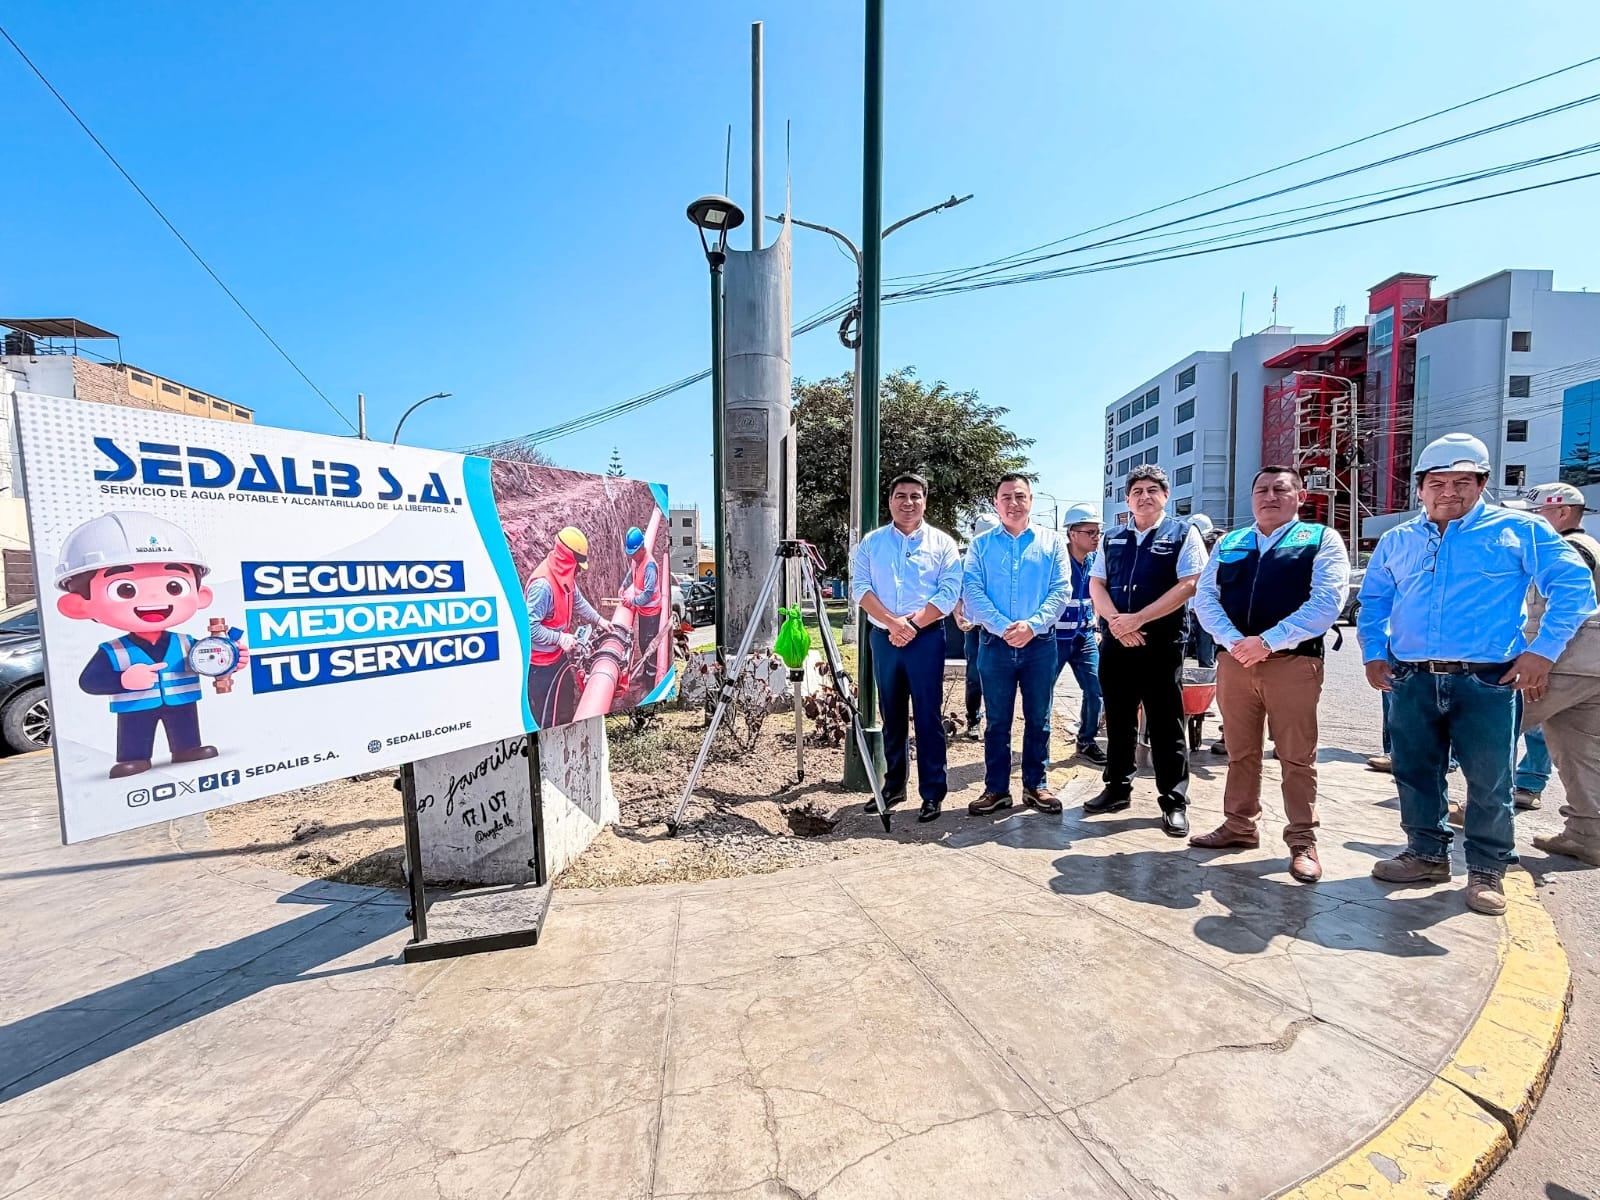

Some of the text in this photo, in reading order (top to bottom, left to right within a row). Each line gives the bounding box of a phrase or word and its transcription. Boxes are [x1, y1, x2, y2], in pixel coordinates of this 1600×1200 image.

[100, 484, 458, 514] SERVICIO DE AGUA POTABLE Y ALCANTARILLADO DE LA LIBERTAD S.A.
[378, 467, 462, 505] S.A.
[253, 564, 454, 595] SEGUIMOS
[259, 599, 493, 641] MEJORANDO
[260, 636, 486, 685] TU SERVICIO
[385, 720, 472, 747] SEDALIB.COM.PE
[244, 755, 311, 778] SEDALIB
[313, 751, 340, 764] S.A.
